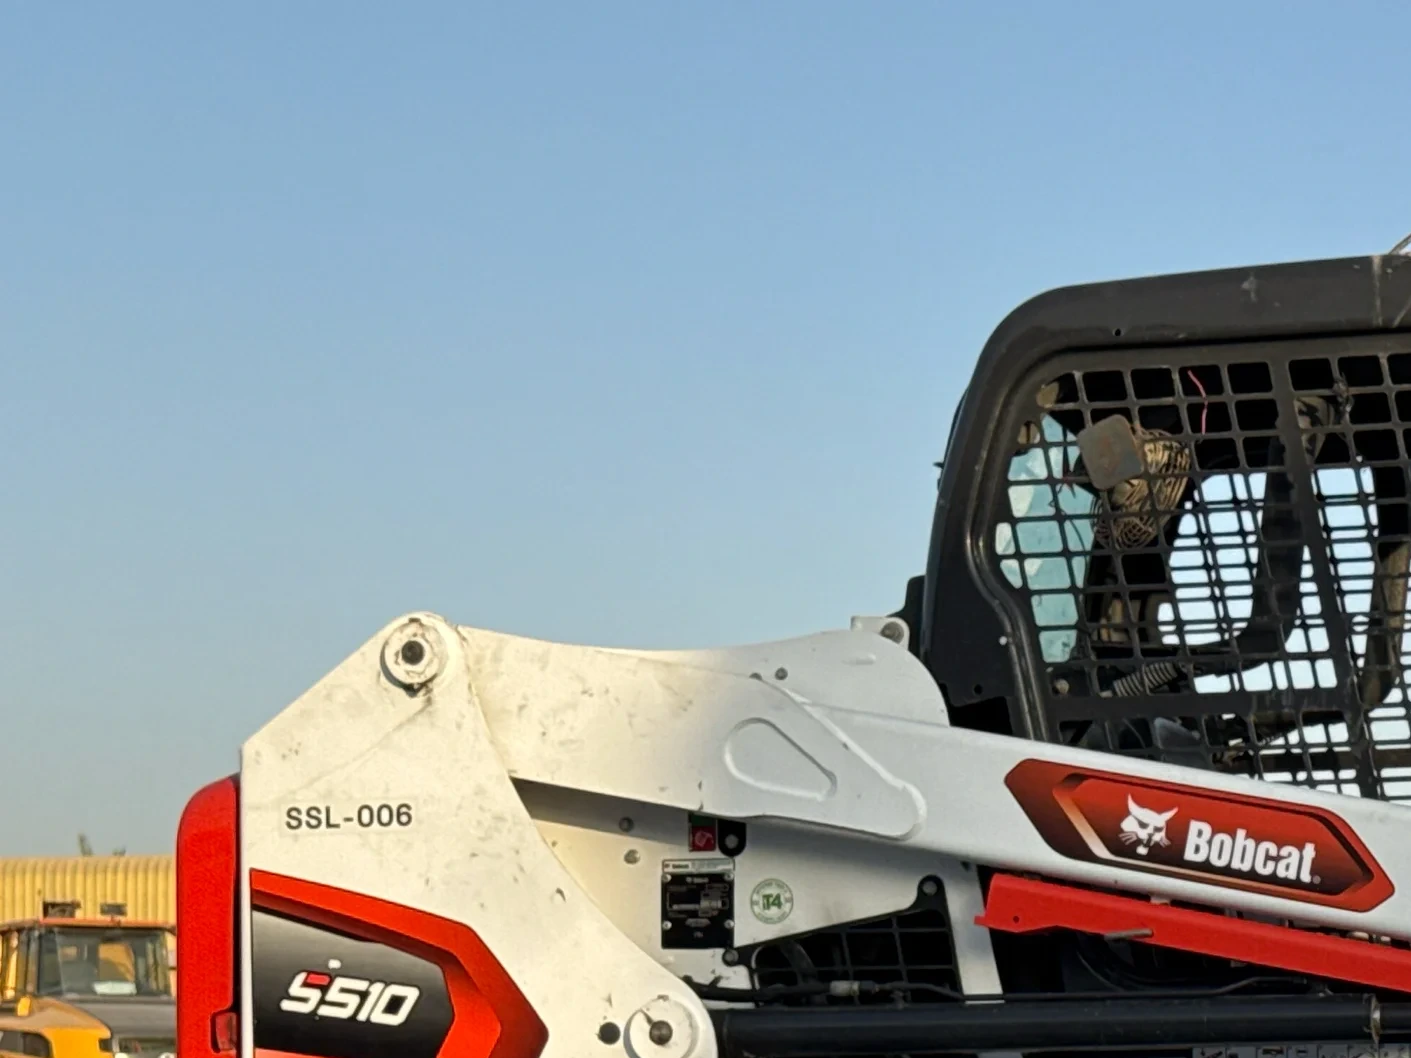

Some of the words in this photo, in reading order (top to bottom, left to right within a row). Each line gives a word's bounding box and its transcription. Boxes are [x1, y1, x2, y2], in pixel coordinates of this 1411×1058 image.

[284, 803, 414, 830] SSL-006
[1183, 819, 1317, 884] Bobcat
[279, 970, 420, 1027] S510
